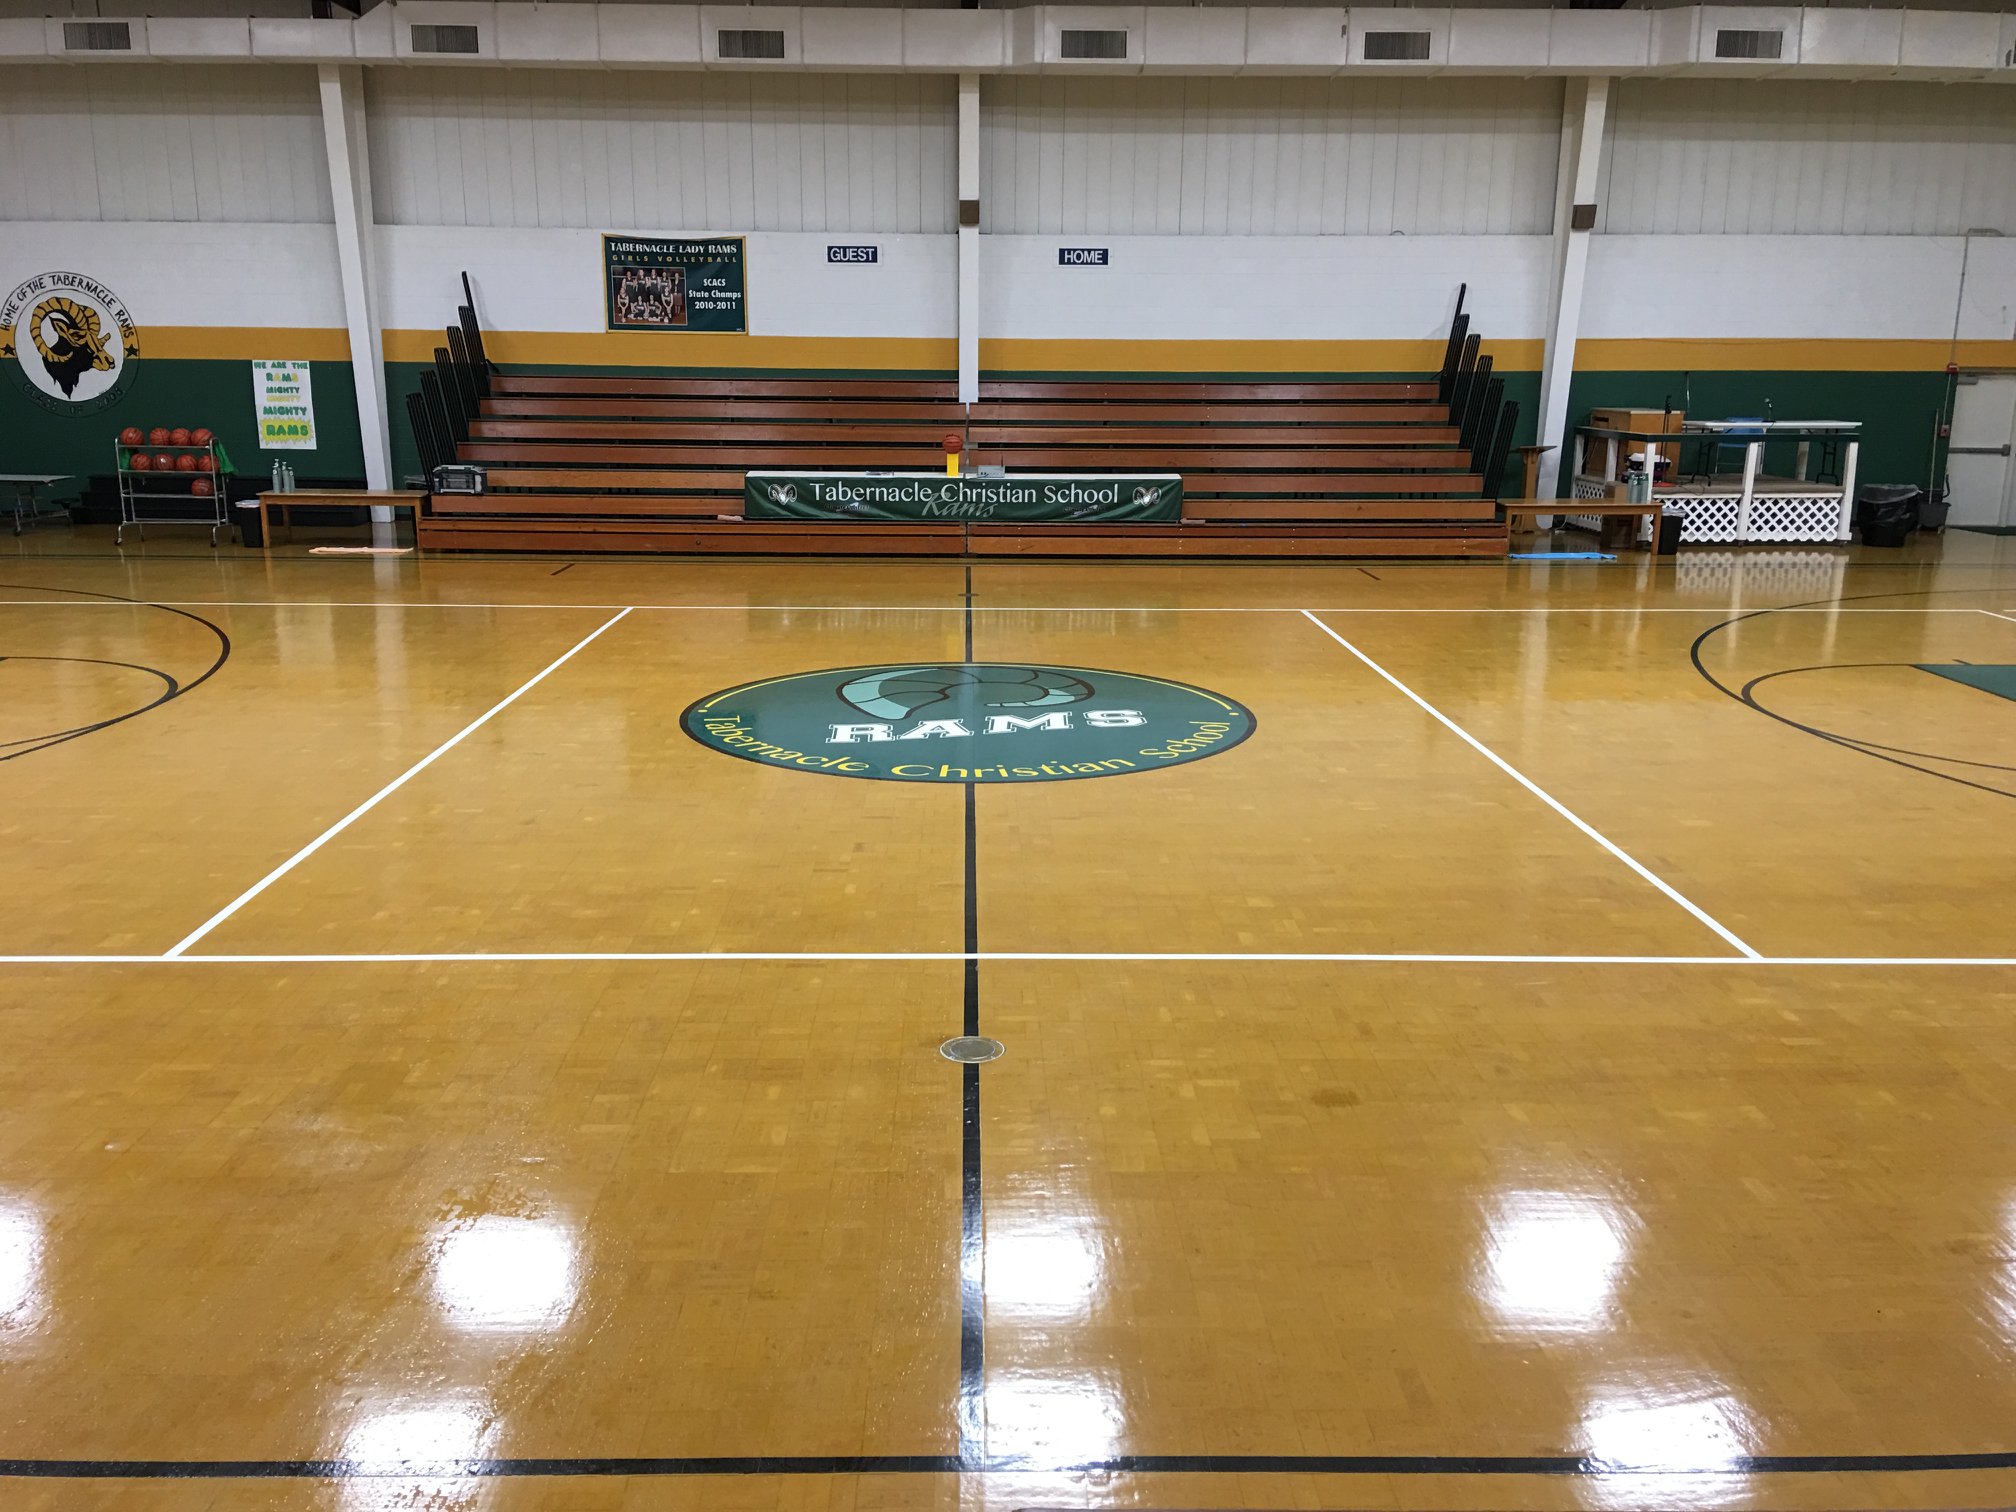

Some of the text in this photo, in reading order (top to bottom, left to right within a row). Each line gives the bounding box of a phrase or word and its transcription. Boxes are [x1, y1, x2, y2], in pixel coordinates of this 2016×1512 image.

[610, 242, 737, 254] TABERNACLE LADY RAMS
[612, 254, 737, 263] GIRLS VOLLEYBALL
[830, 248, 874, 261] GUEST
[1064, 250, 1103, 263] HOME
[703, 278, 726, 287] SCACS
[688, 289, 741, 299] State Champs
[1, 274, 135, 339] HOME OF THE TABERNACLE RAMS
[694, 301, 736, 310] 2010-2011
[254, 361, 309, 370] WE ARE THE
[263, 406, 307, 415] MIGHTY
[266, 424, 308, 436] RAMS
[809, 481, 1118, 504] Tabernacle Christian School
[921, 491, 998, 517] Rams
[826, 708, 1147, 744] RAMS
[703, 715, 1231, 778] Tabernacle Christian School
